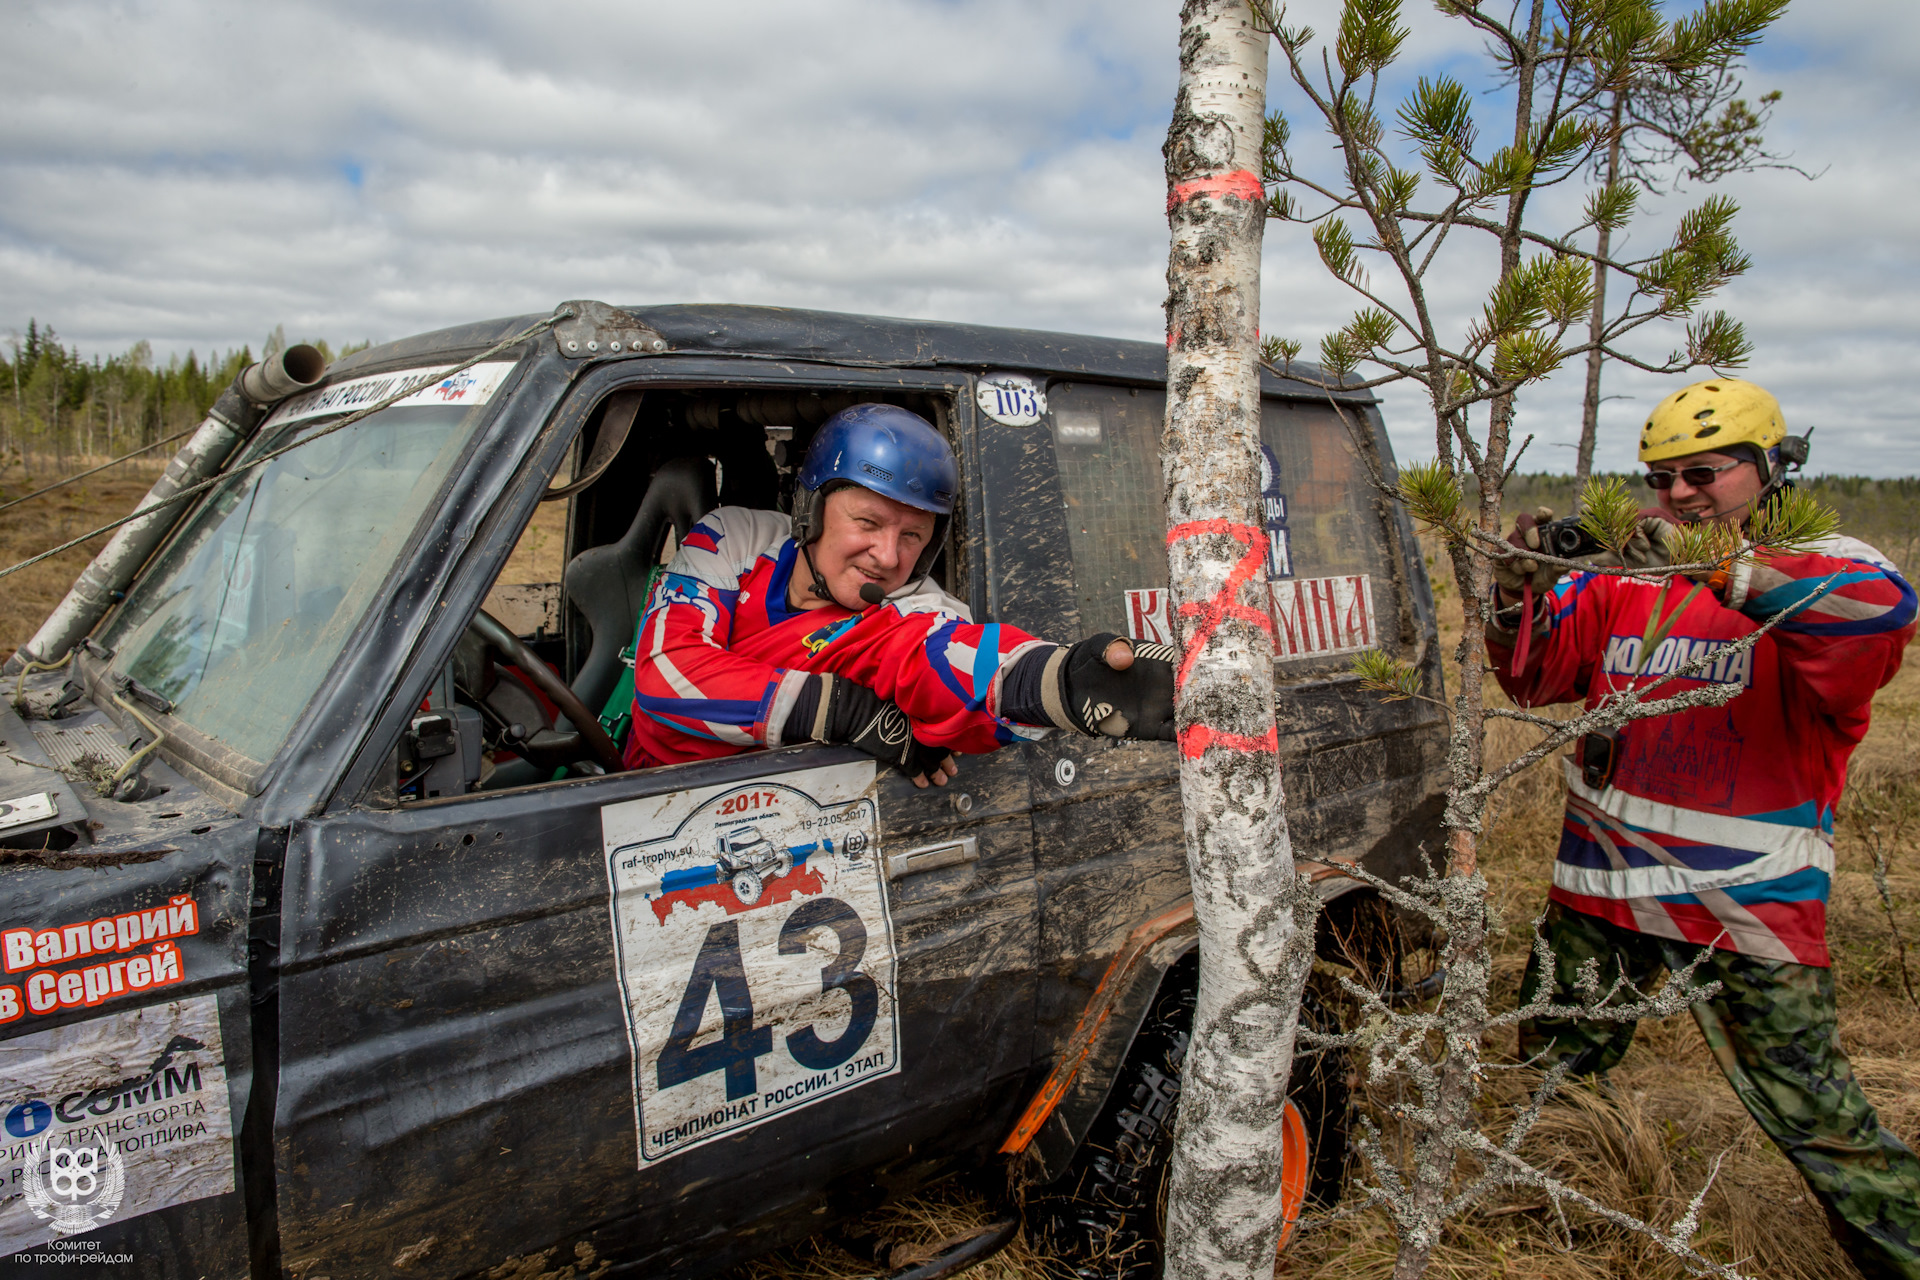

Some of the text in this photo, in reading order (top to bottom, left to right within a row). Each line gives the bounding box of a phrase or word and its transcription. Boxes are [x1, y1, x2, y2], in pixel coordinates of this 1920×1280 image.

[341, 378, 397, 406] РОССИИ
[995, 380, 1037, 417] 103
[1127, 576, 1370, 657] КМНА
[621, 846, 692, 870] raf-trophy.su
[3, 897, 195, 970] Валерий
[27, 943, 179, 1011] Сергей
[656, 897, 879, 1103] 43
[63, 1099, 206, 1146] ТРАНСПОРТА
[651, 1098, 759, 1147] ЧЕМПИОНАТ
[844, 1052, 884, 1078] ЭТАП
[115, 1121, 207, 1153] ТОПЛИВА
